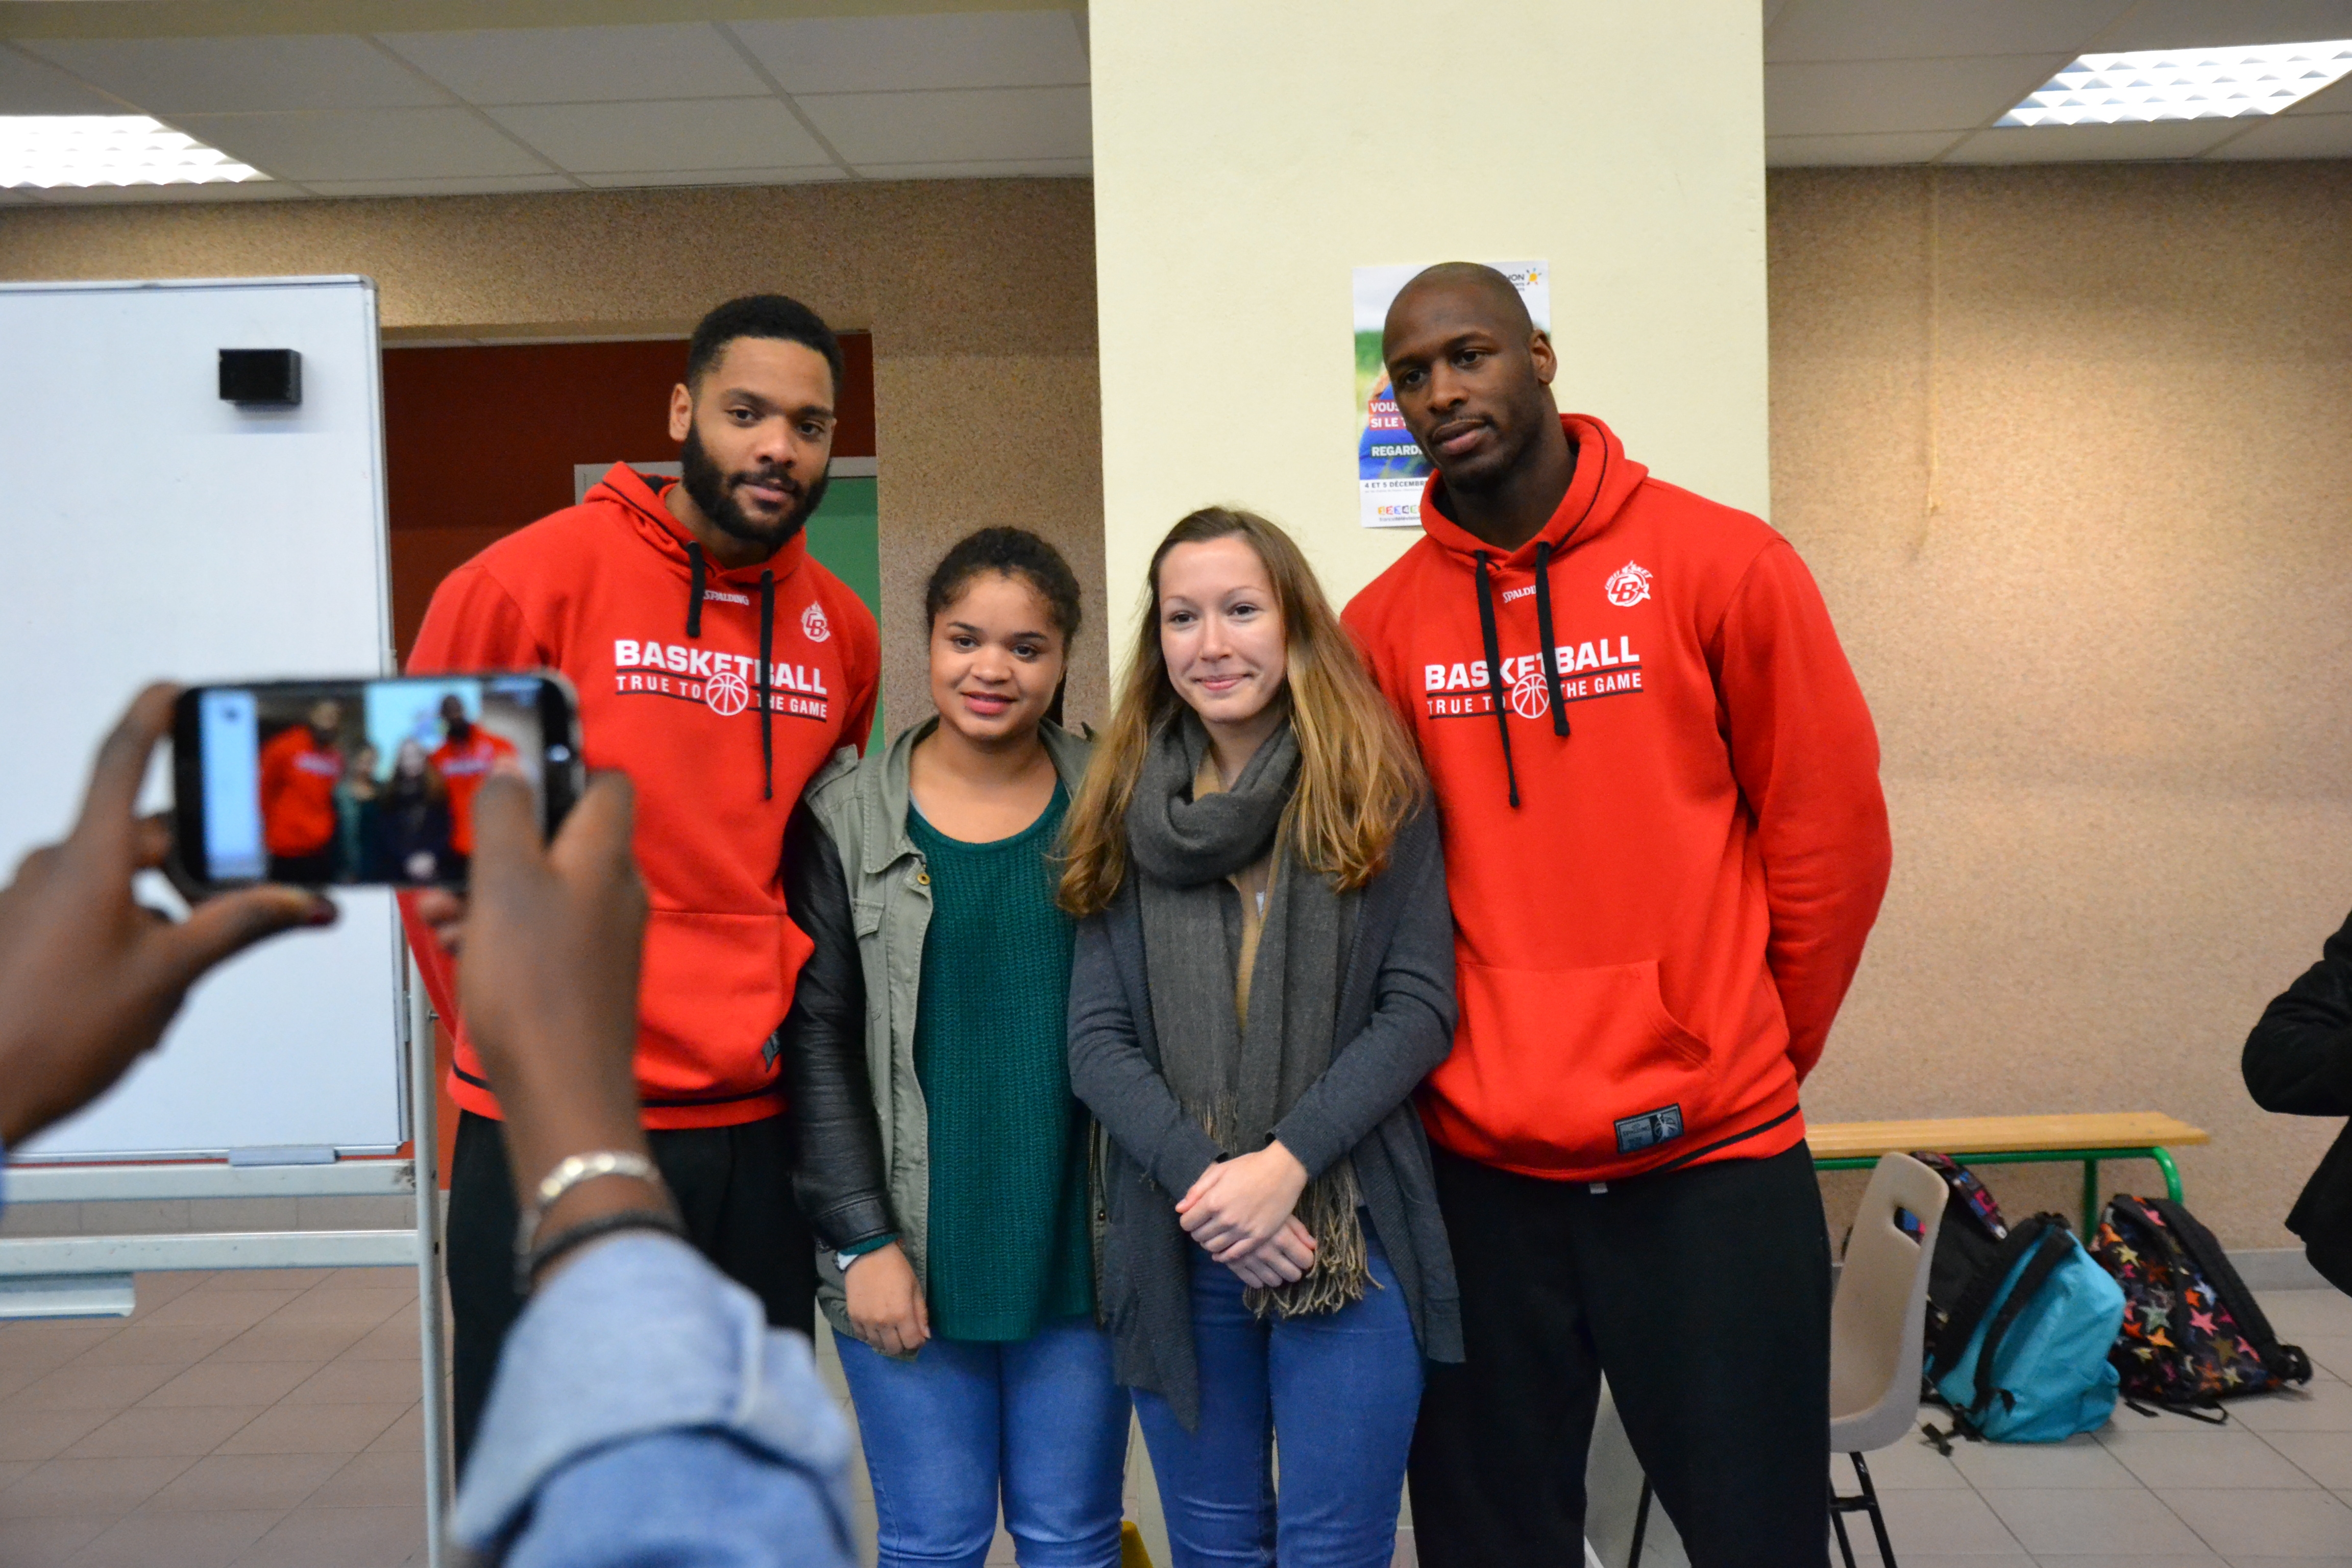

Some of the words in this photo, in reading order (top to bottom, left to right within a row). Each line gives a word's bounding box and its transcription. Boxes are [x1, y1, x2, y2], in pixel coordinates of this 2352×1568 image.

[1370, 418, 1382, 428] SI
[1385, 418, 1398, 427] LE
[703, 589, 749, 606] SPALDING
[615, 640, 827, 695] BASKETBALL
[616, 675, 670, 692] TRUE
[679, 681, 701, 699] TO
[790, 698, 827, 718] GAME
[1427, 697, 1473, 715] TRUE
[1594, 672, 1641, 693] GAME
